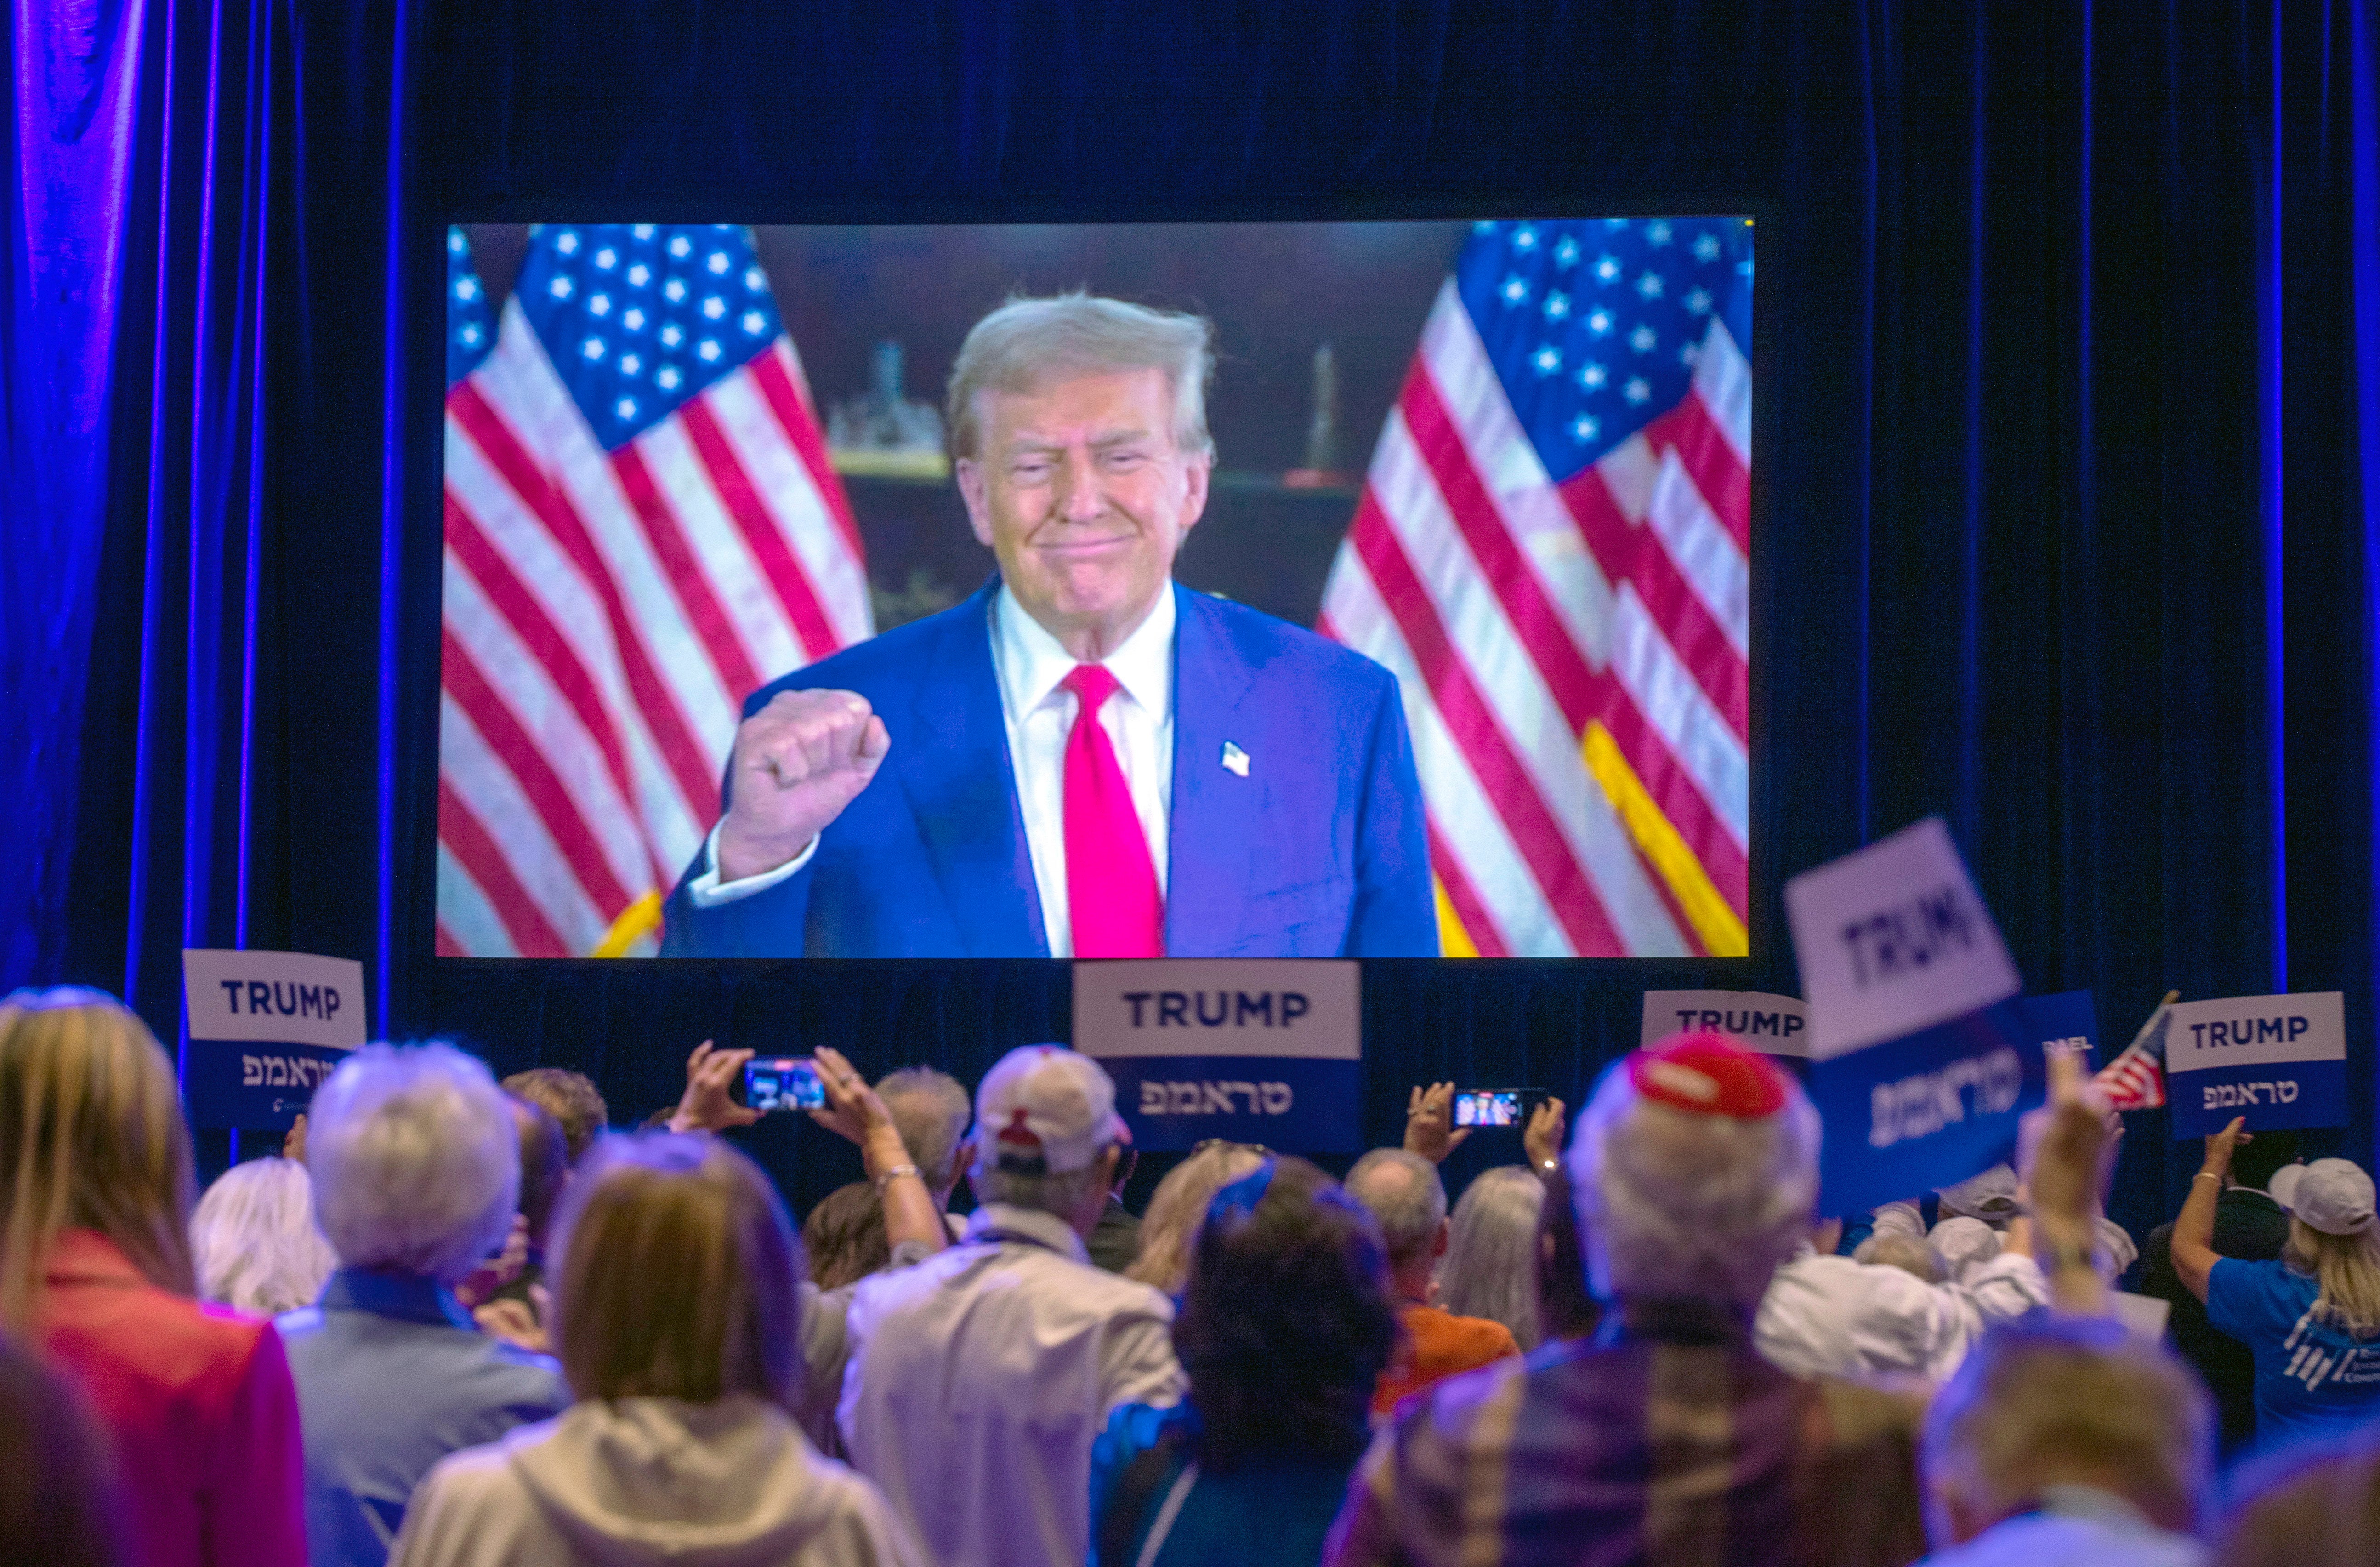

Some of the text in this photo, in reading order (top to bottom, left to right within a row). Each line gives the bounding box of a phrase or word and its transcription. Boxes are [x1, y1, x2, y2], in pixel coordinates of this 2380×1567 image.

[1844, 882, 1973, 993] TRUM
[221, 980, 340, 1020] TRUMP
[1122, 991, 1309, 1028] TRUMP
[1676, 1010, 1804, 1037] TRUMP
[2190, 1016, 2309, 1049] TRUMP
[242, 1054, 335, 1087] ראמפ
[1139, 1080, 1294, 1115] טראמפ
[2203, 1080, 2299, 1110] טראמפ
